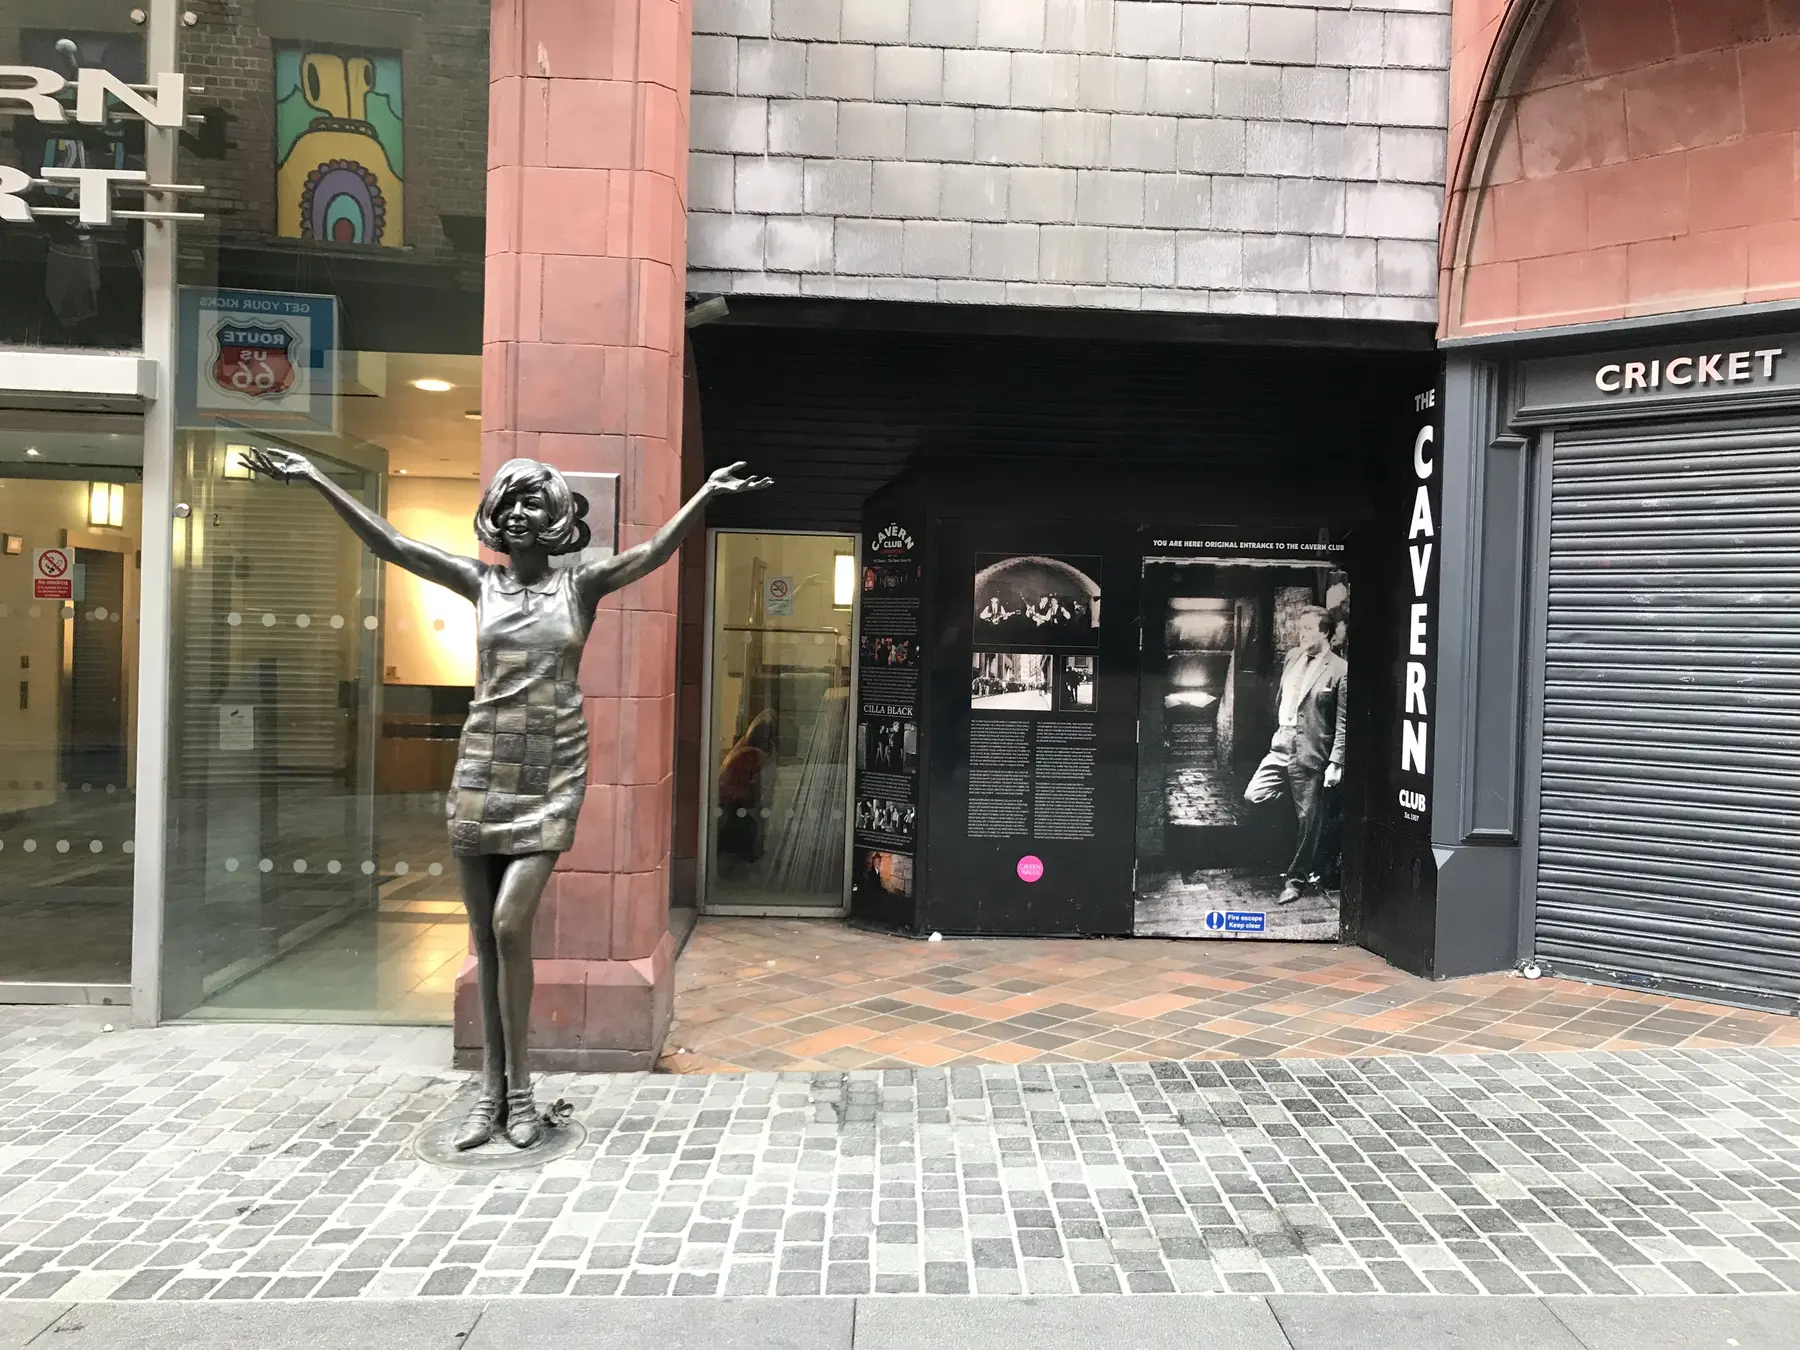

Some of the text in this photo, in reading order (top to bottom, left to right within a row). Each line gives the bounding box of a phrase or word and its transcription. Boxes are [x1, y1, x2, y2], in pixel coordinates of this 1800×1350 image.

[1595, 348, 1782, 392] CRICKET
[1414, 388, 1435, 412] THE
[871, 526, 915, 551] CAVERN
[883, 540, 903, 548] CLUB
[1401, 425, 1435, 775] CAVERN
[864, 704, 913, 716] CILLA BLACK
[1399, 789, 1426, 812] CLUB
[1228, 922, 1244, 930] Keep
